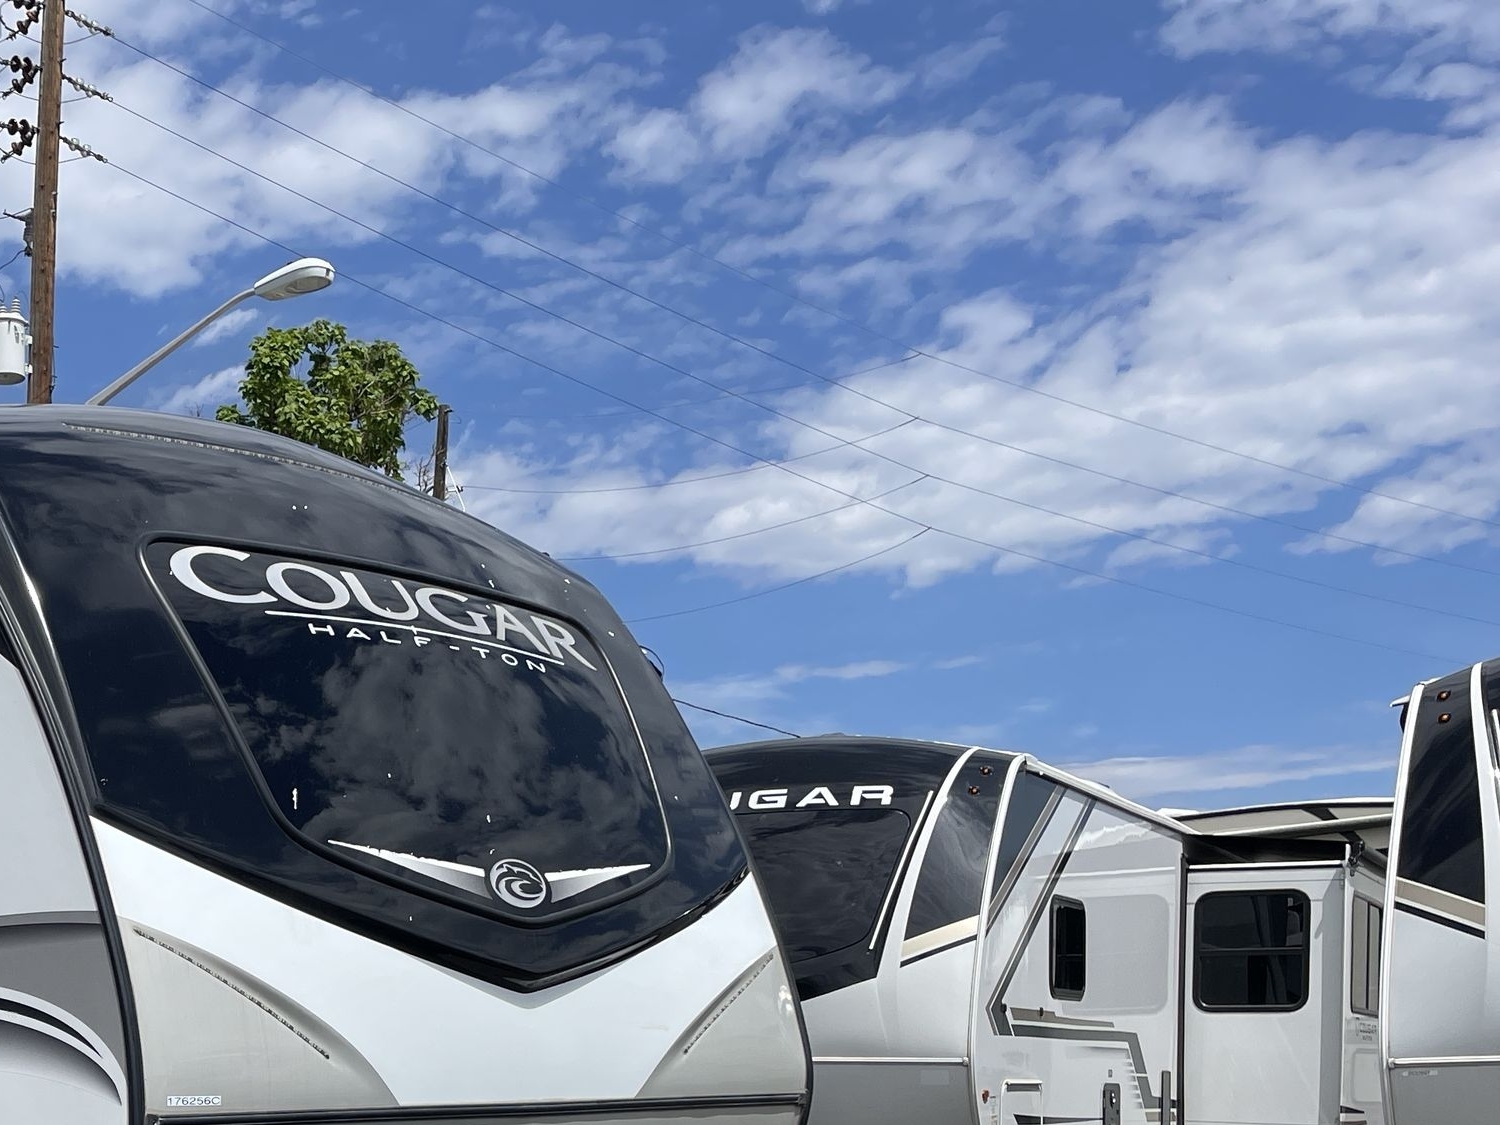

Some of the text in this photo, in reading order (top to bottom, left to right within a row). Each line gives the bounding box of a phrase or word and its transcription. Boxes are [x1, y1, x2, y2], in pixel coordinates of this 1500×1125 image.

[169, 545, 597, 671] COUGAR
[308, 622, 546, 673] HALF-TON
[167, 1096, 221, 1106] 176256C
